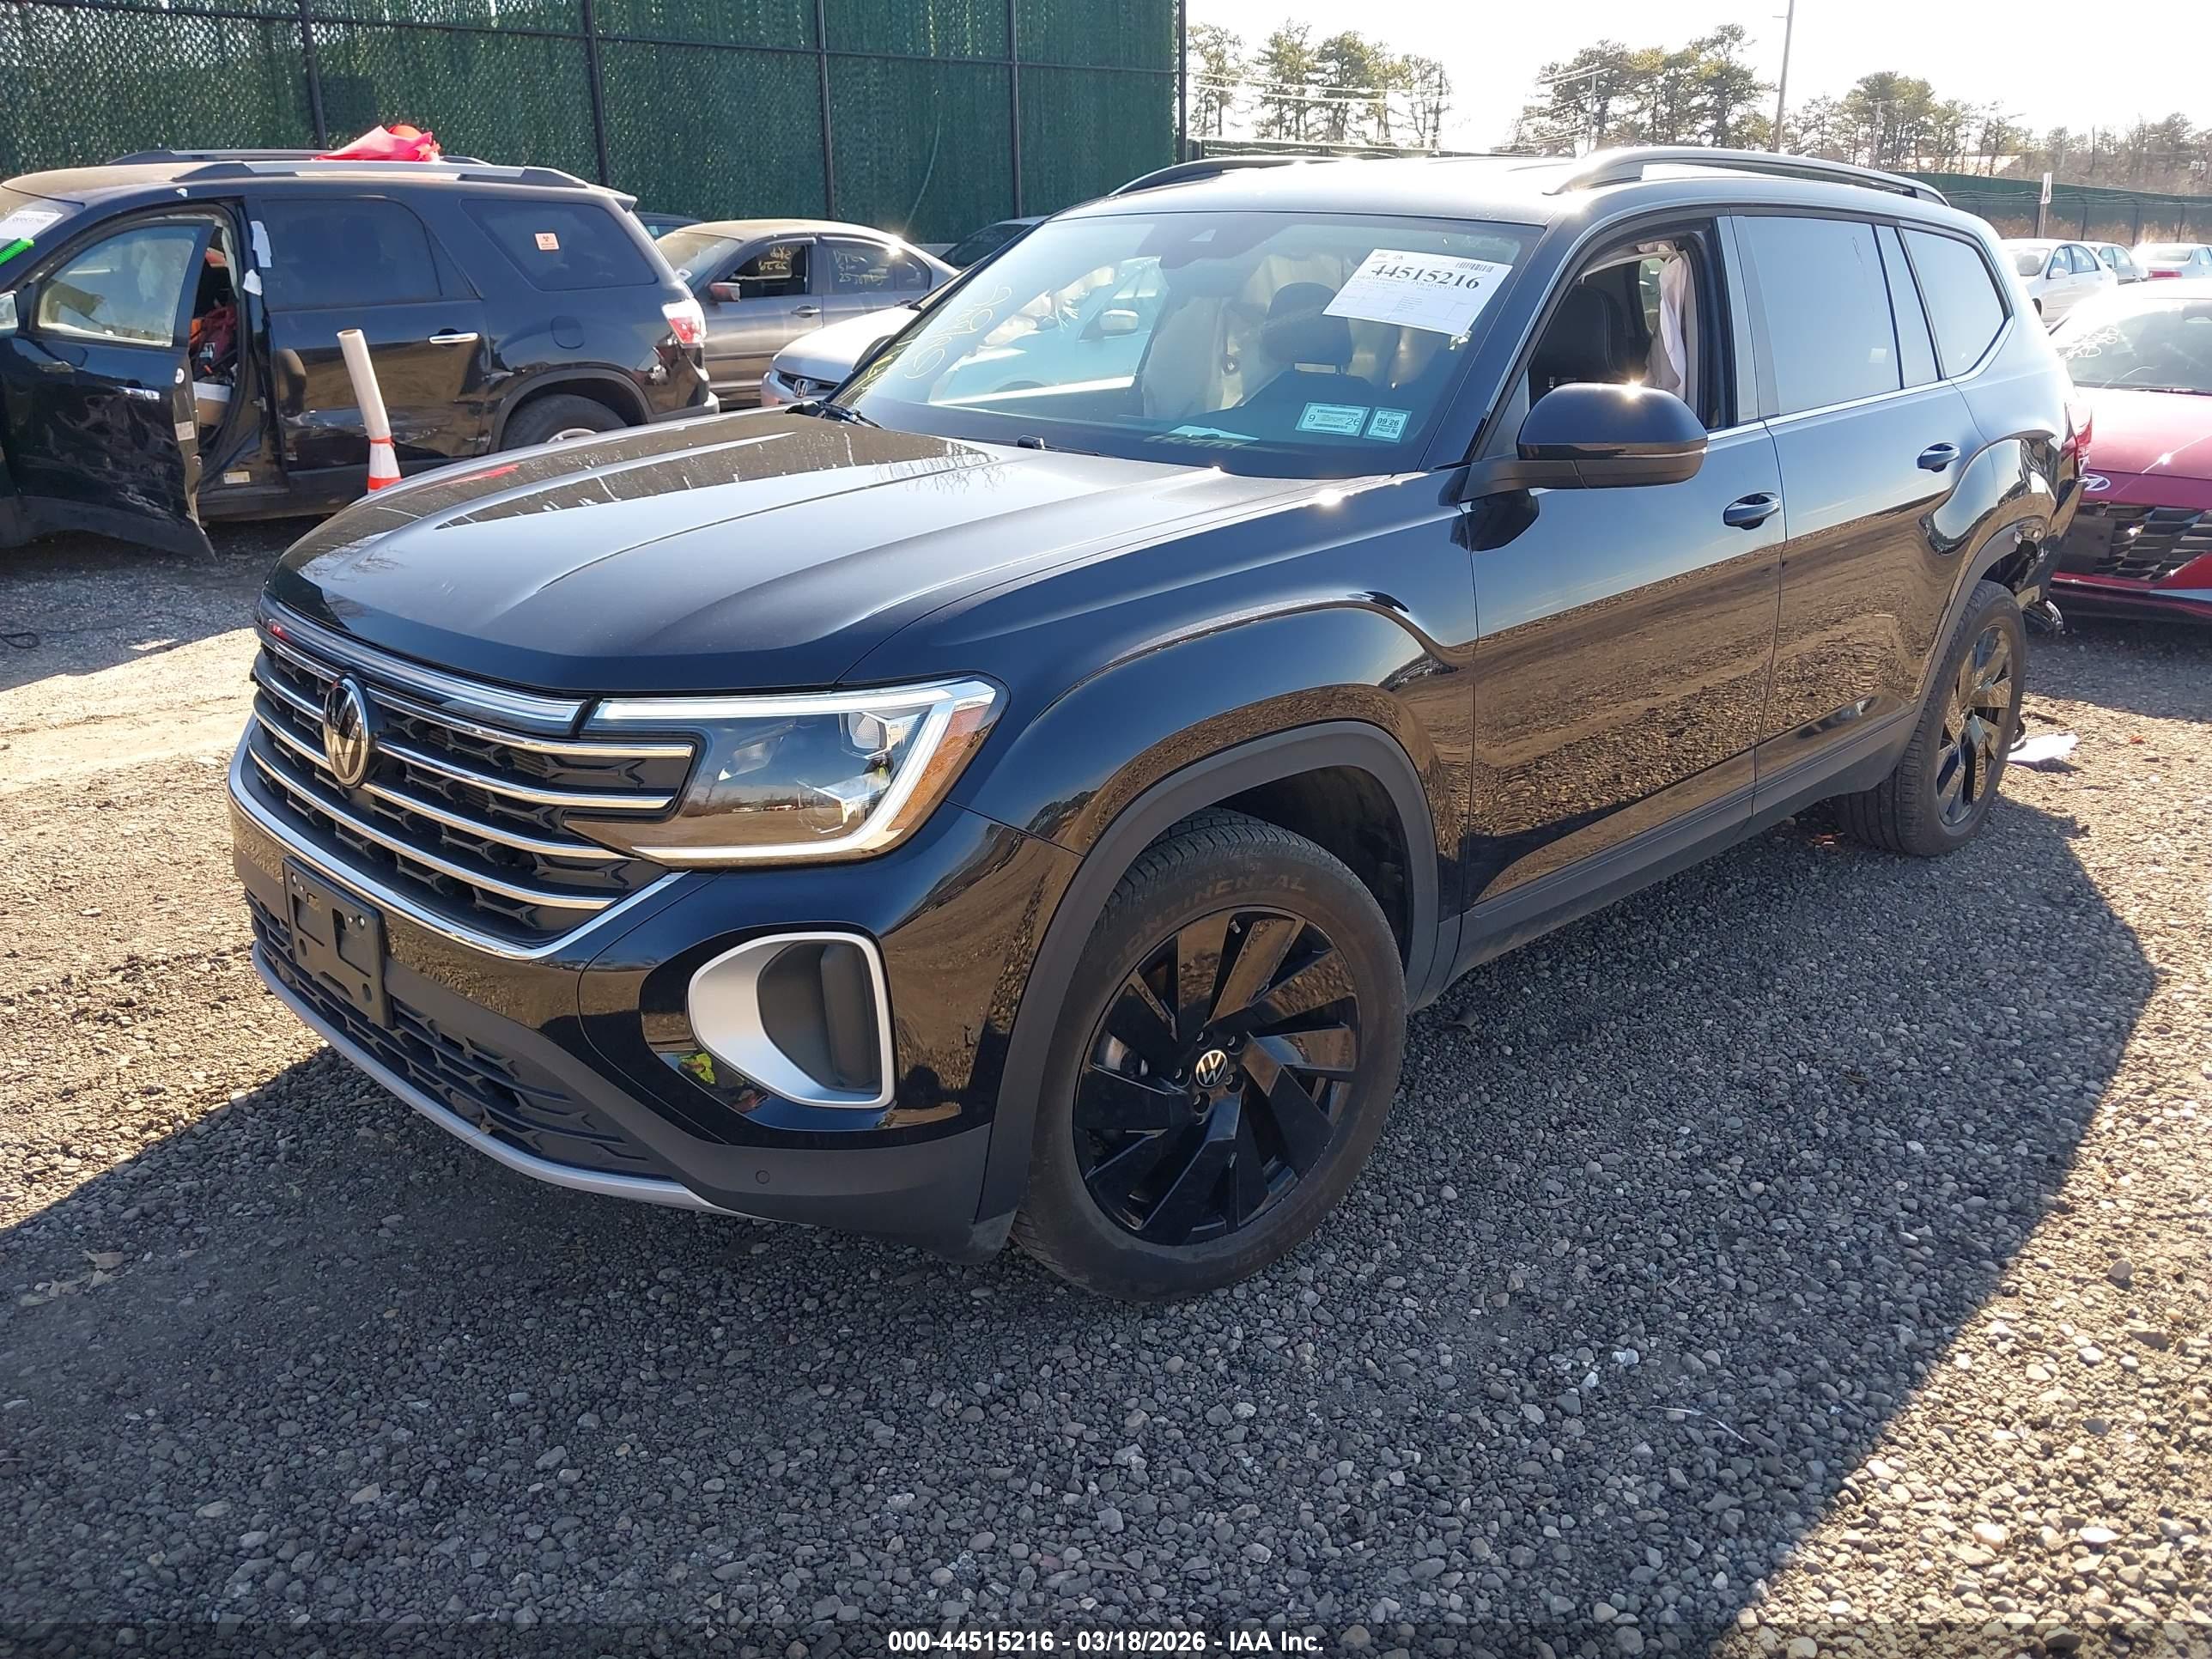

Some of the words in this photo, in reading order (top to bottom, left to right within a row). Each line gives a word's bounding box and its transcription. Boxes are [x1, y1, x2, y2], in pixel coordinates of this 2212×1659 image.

[1371, 264, 1484, 290] 44515216
[1307, 414, 1316, 422] 9
[1346, 417, 1361, 427] 26
